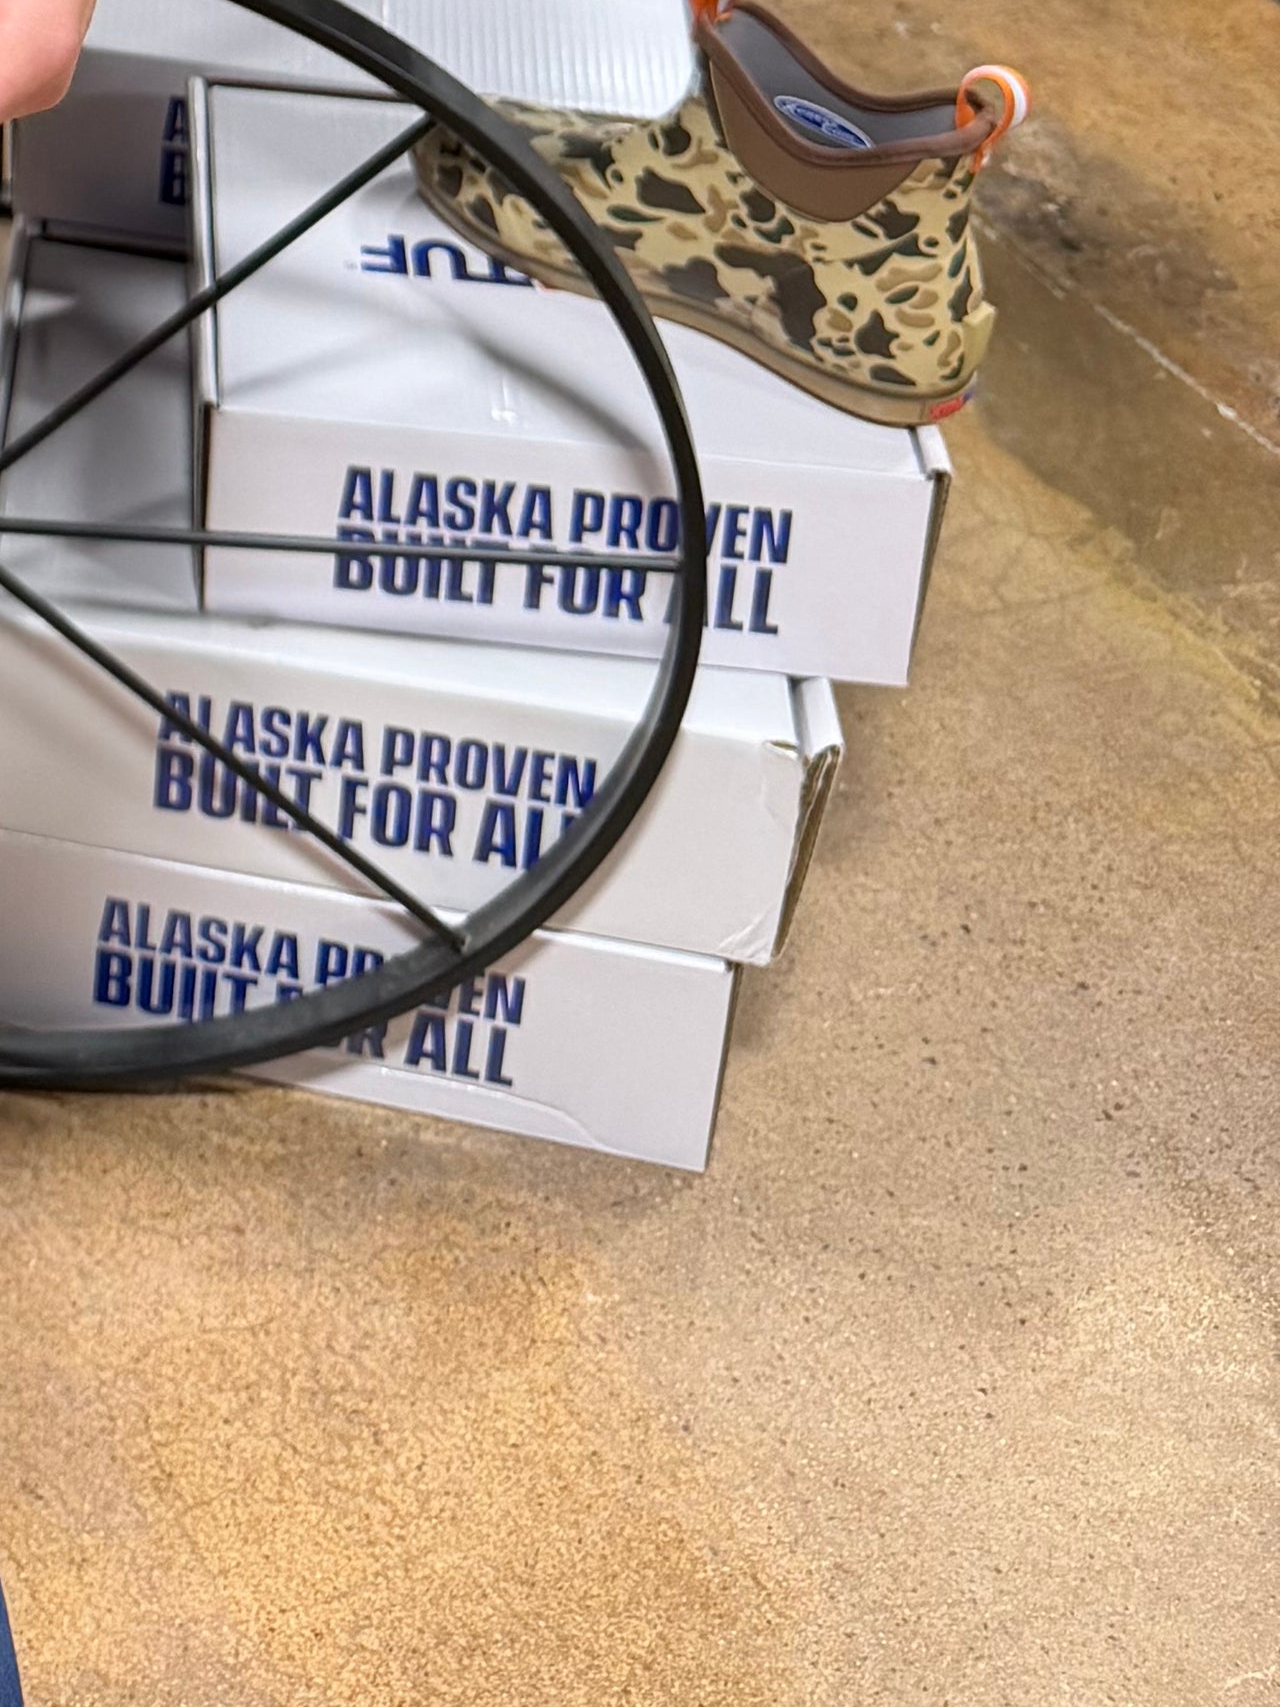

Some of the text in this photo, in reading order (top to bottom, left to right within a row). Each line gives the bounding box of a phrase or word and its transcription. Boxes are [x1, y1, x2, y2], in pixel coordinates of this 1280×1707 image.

[338, 464, 554, 541] ALASKA
[333, 524, 781, 635] BUILT FOR LL
[153, 743, 584, 871] BUILT FOR AL
[157, 690, 598, 809] ALASKA PROVEN
[98, 895, 300, 981] ALASKA
[314, 937, 528, 1027] PREN
[403, 1010, 514, 1087] ALL
